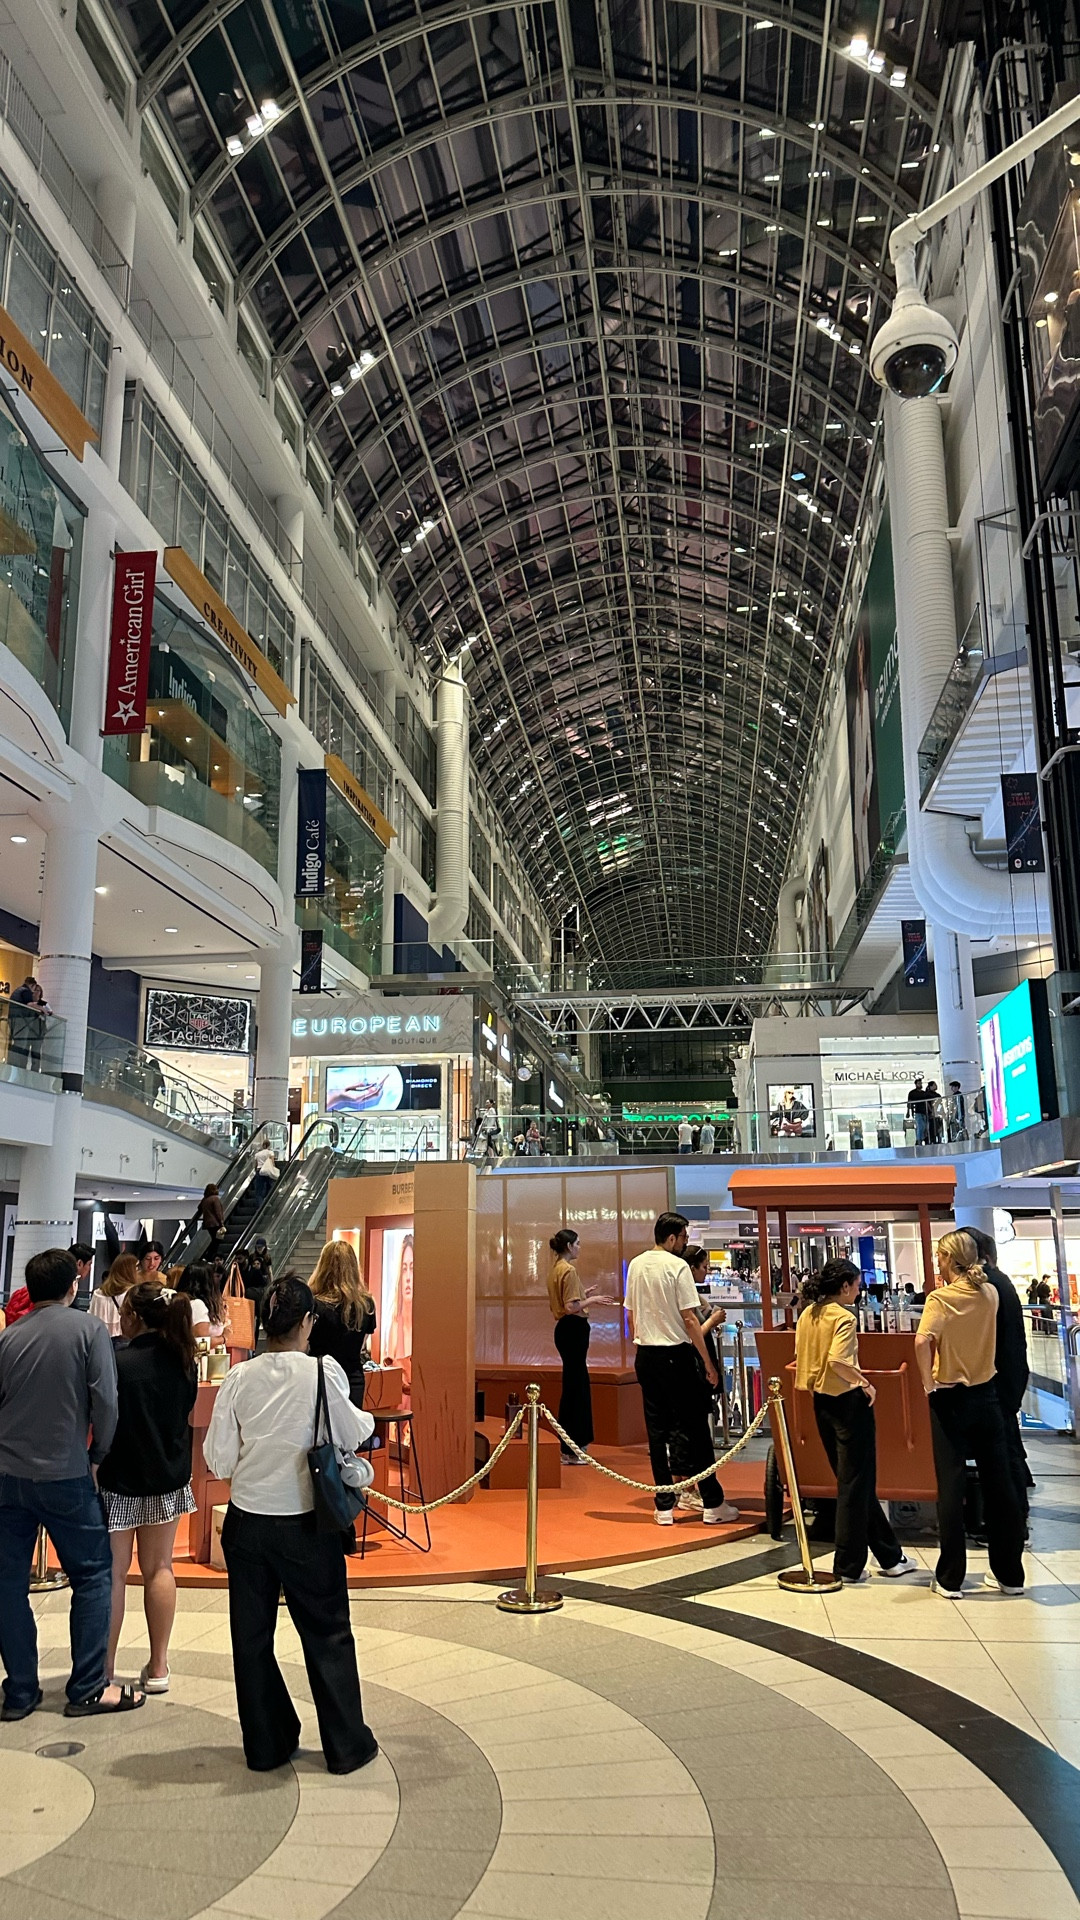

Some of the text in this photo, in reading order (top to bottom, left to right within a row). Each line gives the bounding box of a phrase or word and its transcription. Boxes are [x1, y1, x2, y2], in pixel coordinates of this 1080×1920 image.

[118, 606, 144, 697] American
[203, 602, 258, 679] CREATIVITY
[343, 780, 376, 828] INSPIRATION
[301, 820, 322, 892] Indigo Café
[292, 1014, 441, 1036] EUROPEAN
[391, 1037, 437, 1045] BOUTIQUE
[834, 1071, 925, 1081] MICHAEL KORS
